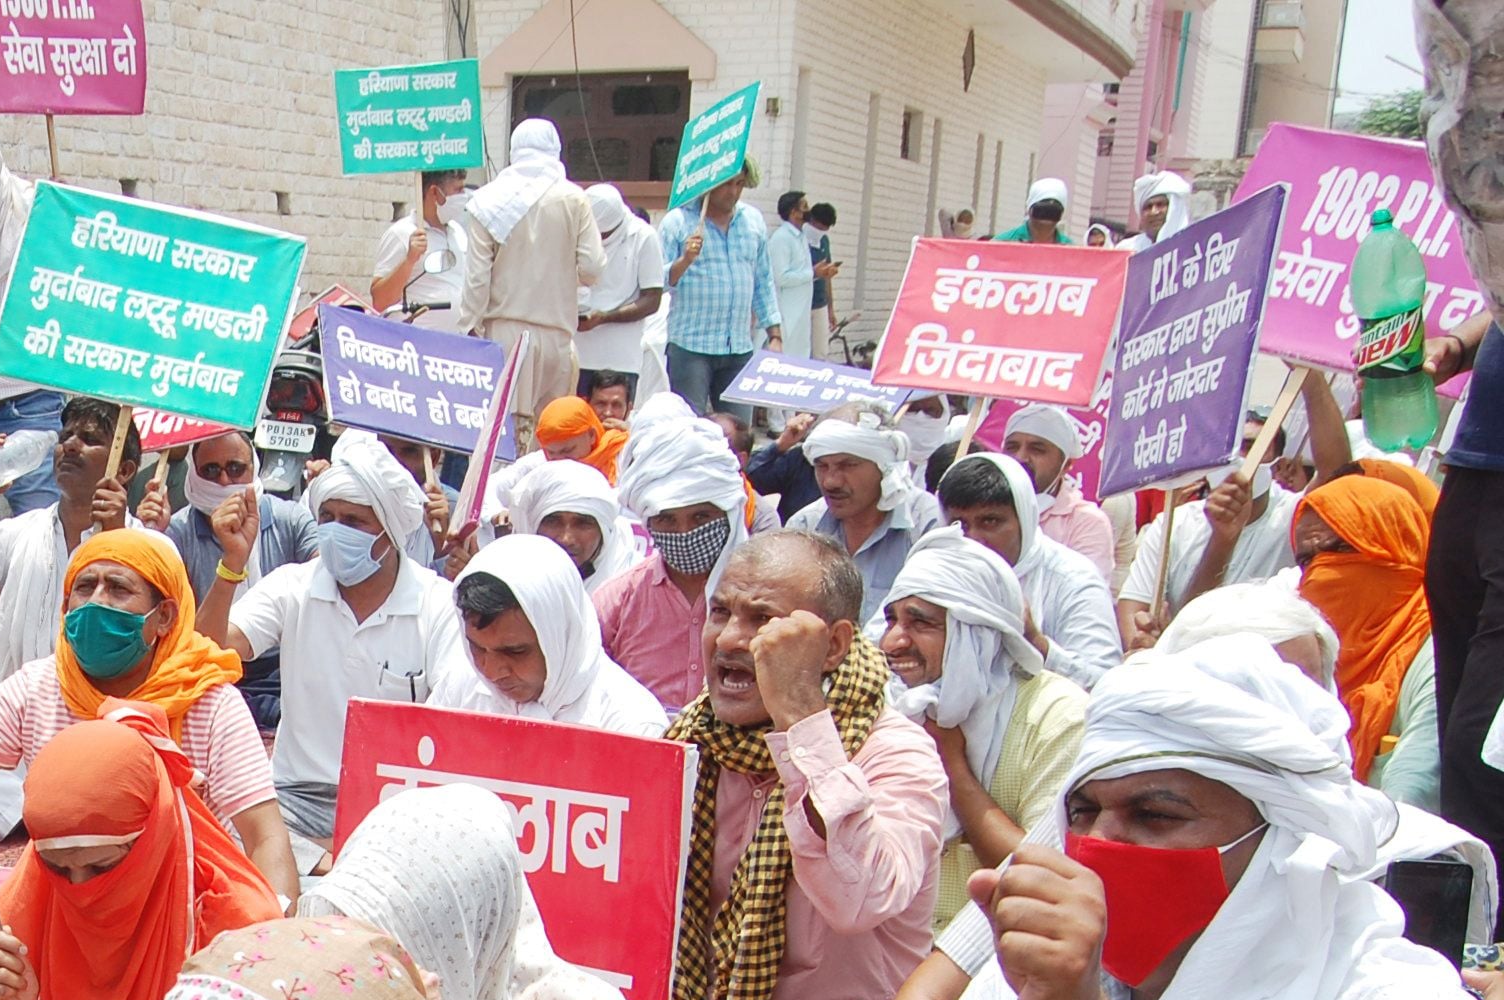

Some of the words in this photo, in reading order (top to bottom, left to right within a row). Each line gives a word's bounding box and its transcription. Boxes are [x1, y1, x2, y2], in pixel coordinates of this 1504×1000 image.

[0, 21, 46, 75] सेवा
[48, 37, 108, 97] सुरक्षा
[111, 24, 137, 76] दो
[358, 71, 409, 96] हरियाणा
[412, 72, 458, 91] सरकार
[353, 137, 372, 160] की
[374, 141, 419, 159] सरकार
[71, 210, 169, 263] हरियाणा
[171, 238, 257, 283] सरकार
[1182, 242, 1203, 290] के
[1203, 231, 1241, 284] लिए
[29, 265, 123, 313] मुर्दाबाद
[181, 303, 269, 343] मण्डली
[931, 254, 1099, 317] इंकलाब
[23, 319, 62, 359] की
[63, 334, 151, 379] सरकार
[149, 352, 244, 397] मुर्दाबाद
[422, 354, 494, 392] सरकार
[899, 322, 1084, 392] जिंदाबाद
[1121, 322, 1173, 372] सरकार
[336, 370, 362, 405] हो
[364, 380, 418, 417] बर्बाद
[426, 391, 451, 425] हो
[1167, 357, 1227, 404] जोरदार
[1133, 418, 1167, 471] पैरवी
[1166, 414, 1187, 466] हो
